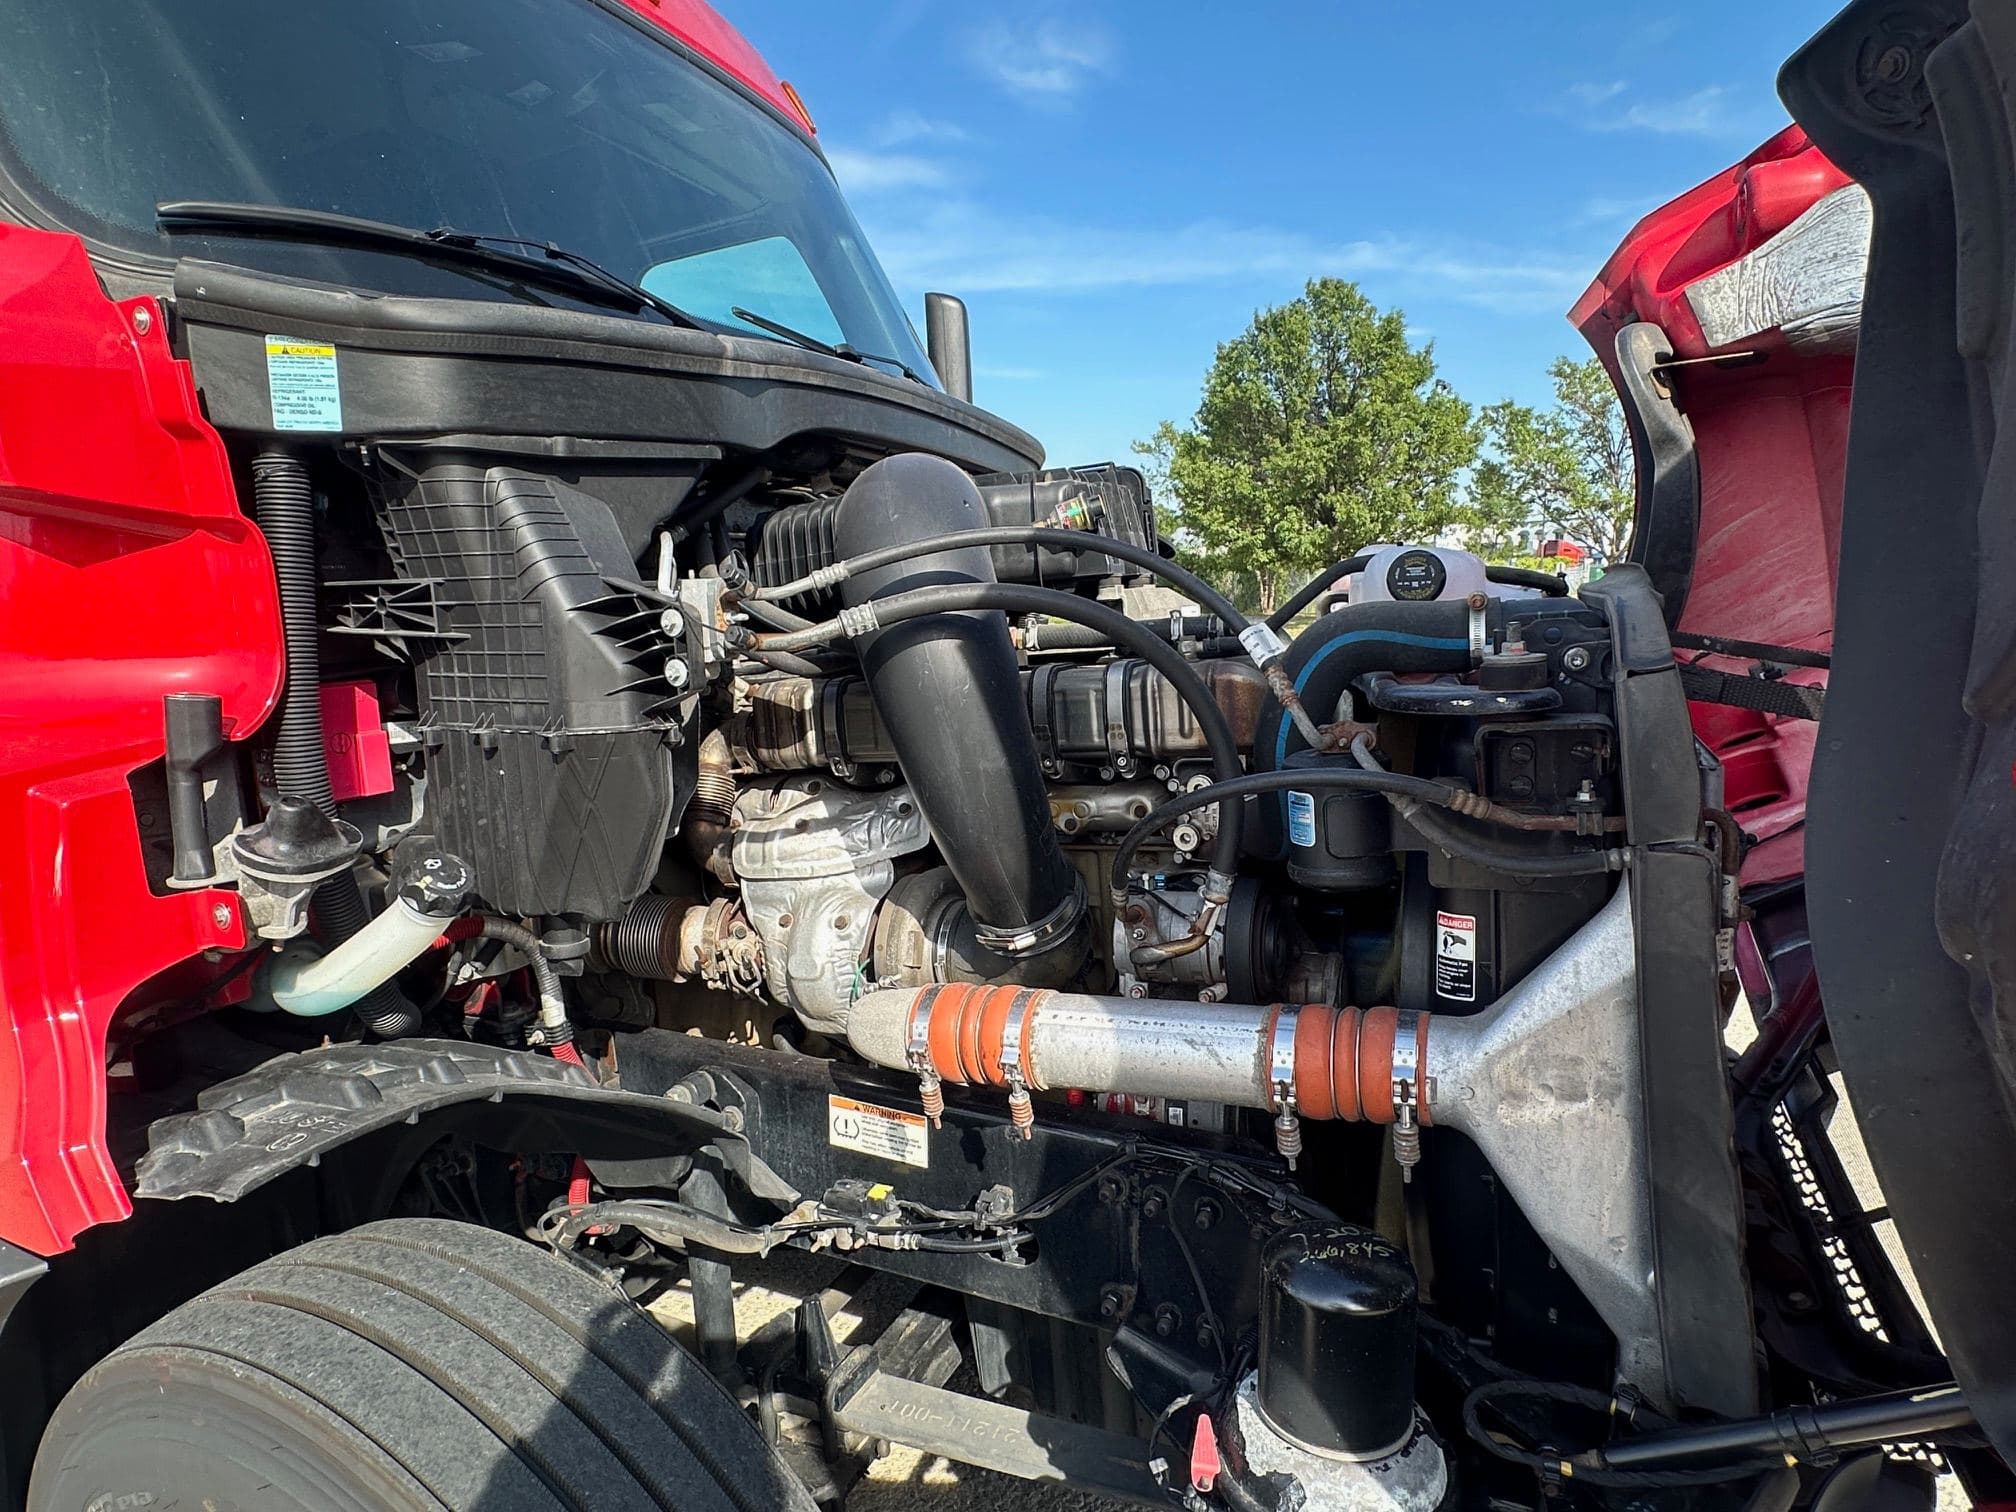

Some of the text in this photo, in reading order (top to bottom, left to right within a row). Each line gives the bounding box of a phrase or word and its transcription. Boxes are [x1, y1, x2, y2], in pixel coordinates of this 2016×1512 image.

[290, 346, 321, 355] CAUTION
[1444, 917, 1473, 930] DANGER
[862, 1104, 903, 1121] WARNING
